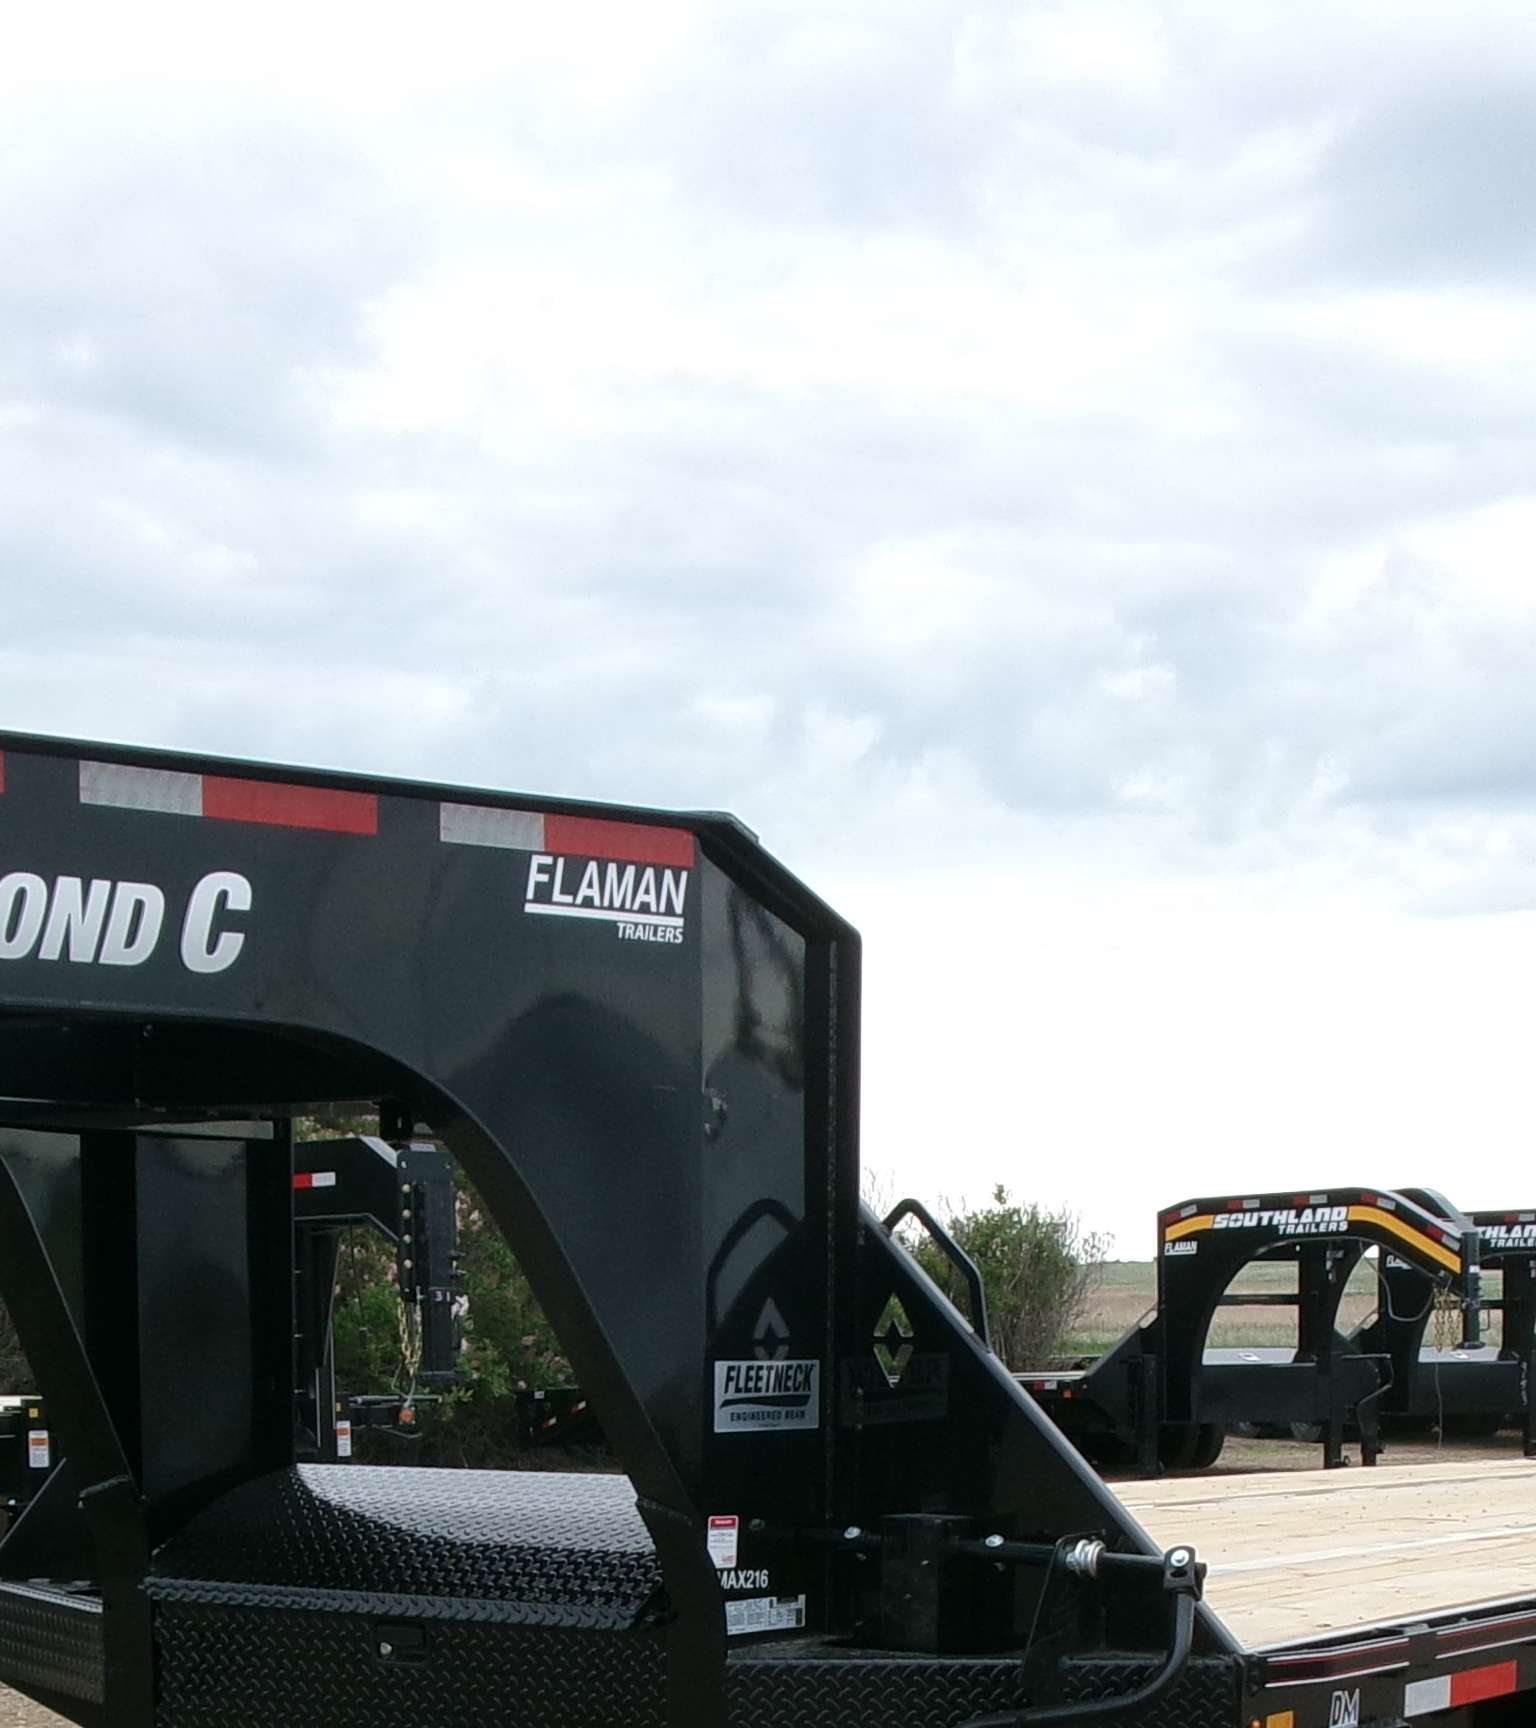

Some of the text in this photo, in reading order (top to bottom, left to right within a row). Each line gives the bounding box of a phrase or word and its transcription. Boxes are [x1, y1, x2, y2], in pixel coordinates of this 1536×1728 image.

[525, 854, 688, 914] FLAMAN
[180, 871, 253, 974] C
[617, 922, 683, 944] TRAILERS
[1212, 1206, 1349, 1229] SOUTHLAND
[1278, 1220, 1349, 1235] TRAILERS
[723, 1363, 815, 1394] FLEETNECK
